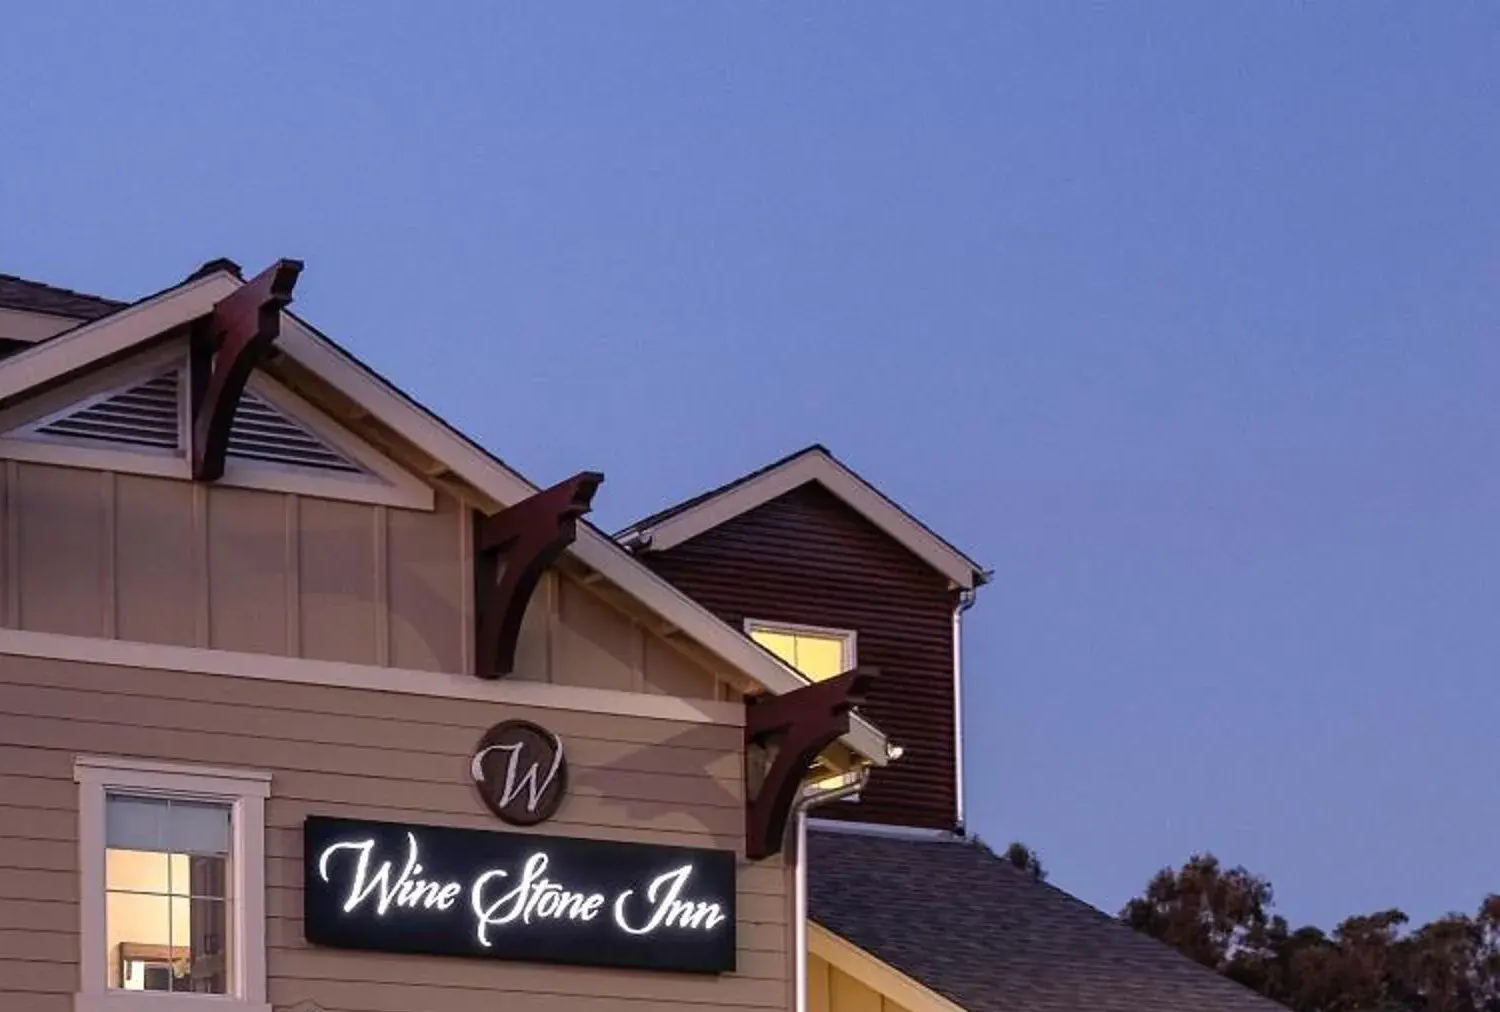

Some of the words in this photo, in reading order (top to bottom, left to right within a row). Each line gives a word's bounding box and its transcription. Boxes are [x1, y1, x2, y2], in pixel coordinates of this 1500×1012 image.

[471, 732, 564, 812] W
[318, 832, 461, 916] Wine
[472, 852, 605, 947] Stone
[614, 864, 725, 935] Inn
